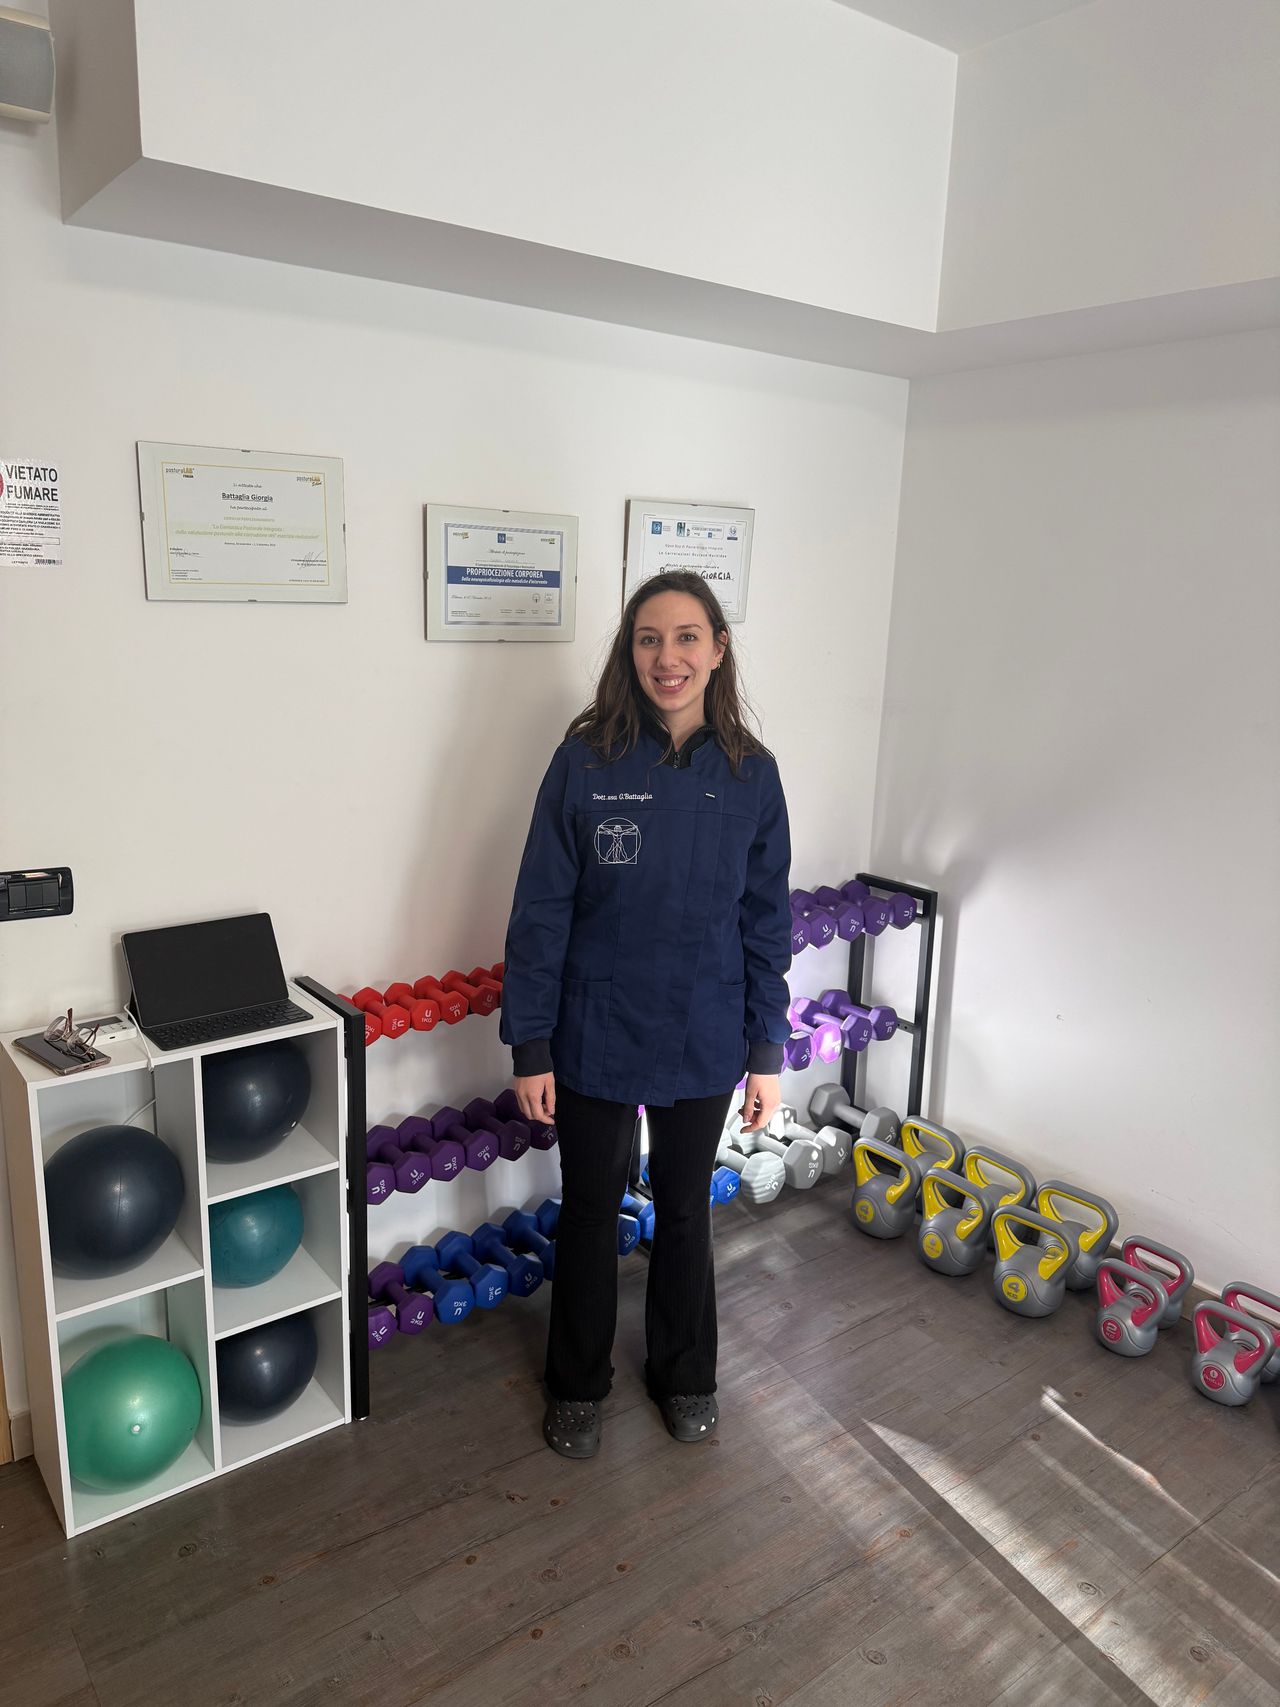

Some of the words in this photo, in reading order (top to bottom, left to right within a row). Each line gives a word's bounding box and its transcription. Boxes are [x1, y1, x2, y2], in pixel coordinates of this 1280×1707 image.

[6, 464, 58, 482] VIETATO
[6, 485, 58, 502] FUMARE
[222, 492, 250, 500] Battaglia
[251, 494, 273, 502] Giorgia
[466, 567, 514, 577] PROPRIOCEZIONE
[515, 570, 544, 579] CORPOREA
[701, 570, 731, 580] GIORGIA
